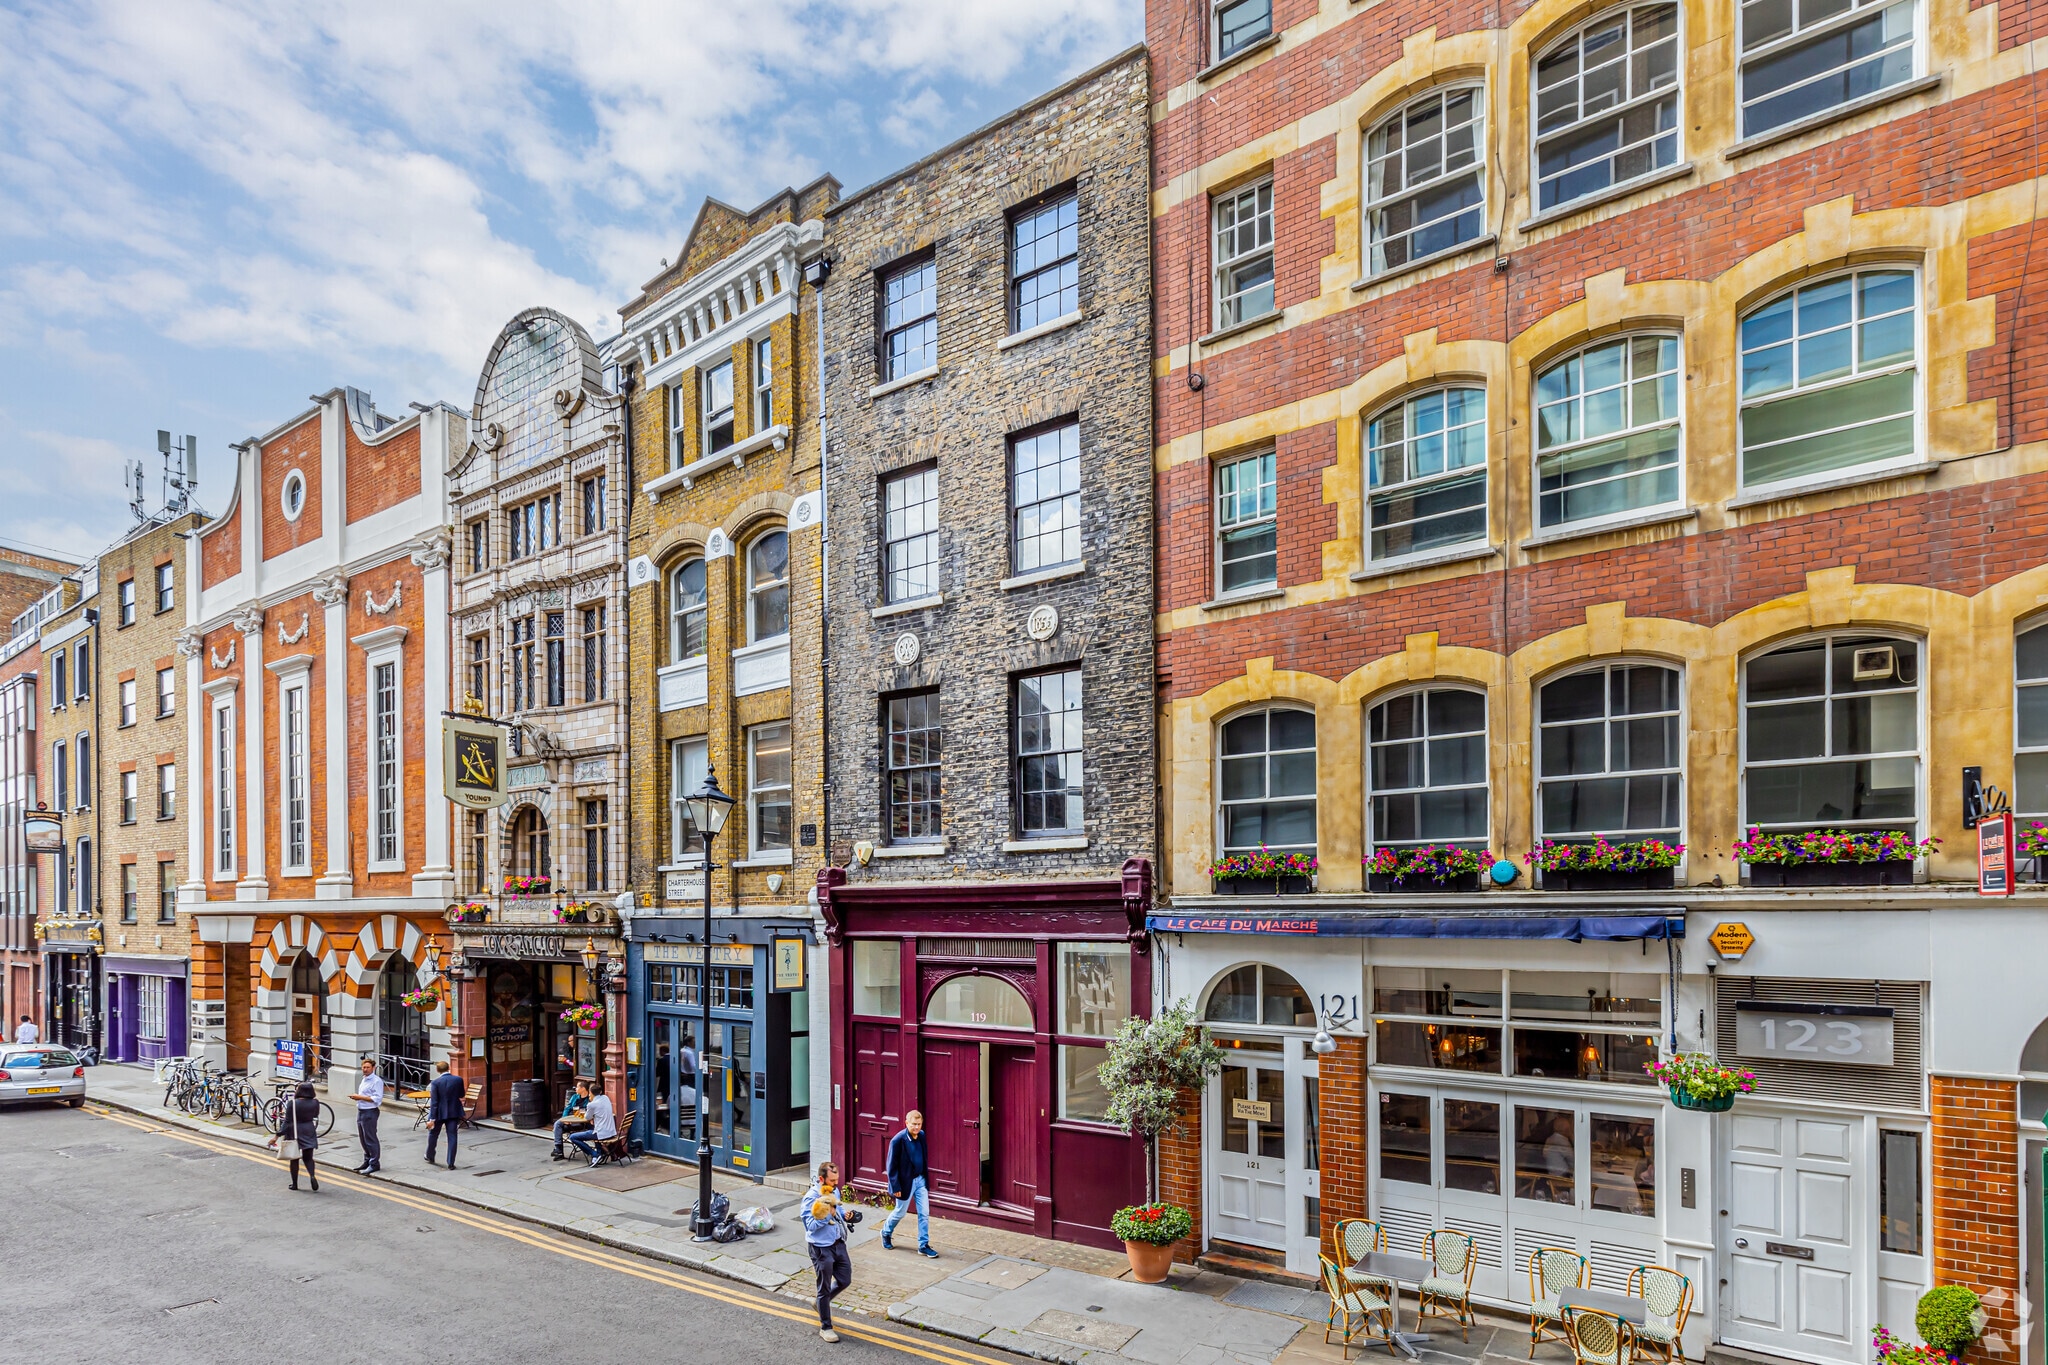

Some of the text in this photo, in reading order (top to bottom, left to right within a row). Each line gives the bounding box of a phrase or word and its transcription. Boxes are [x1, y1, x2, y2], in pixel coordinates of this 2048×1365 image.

[465, 793, 491, 802] YOUNG'S
[668, 878, 705, 887] CHARTERHOUSE
[668, 889, 685, 897] STREET
[1167, 918, 1318, 933] LE CAFÉ DU MARCHÉ
[654, 946, 742, 961] THE VETRY
[1320, 993, 1358, 1020] 121
[971, 1012, 986, 1023] 119
[1760, 1019, 1863, 1055] 123
[281, 1041, 299, 1053] TO LET
[1247, 1161, 1260, 1169] 121
